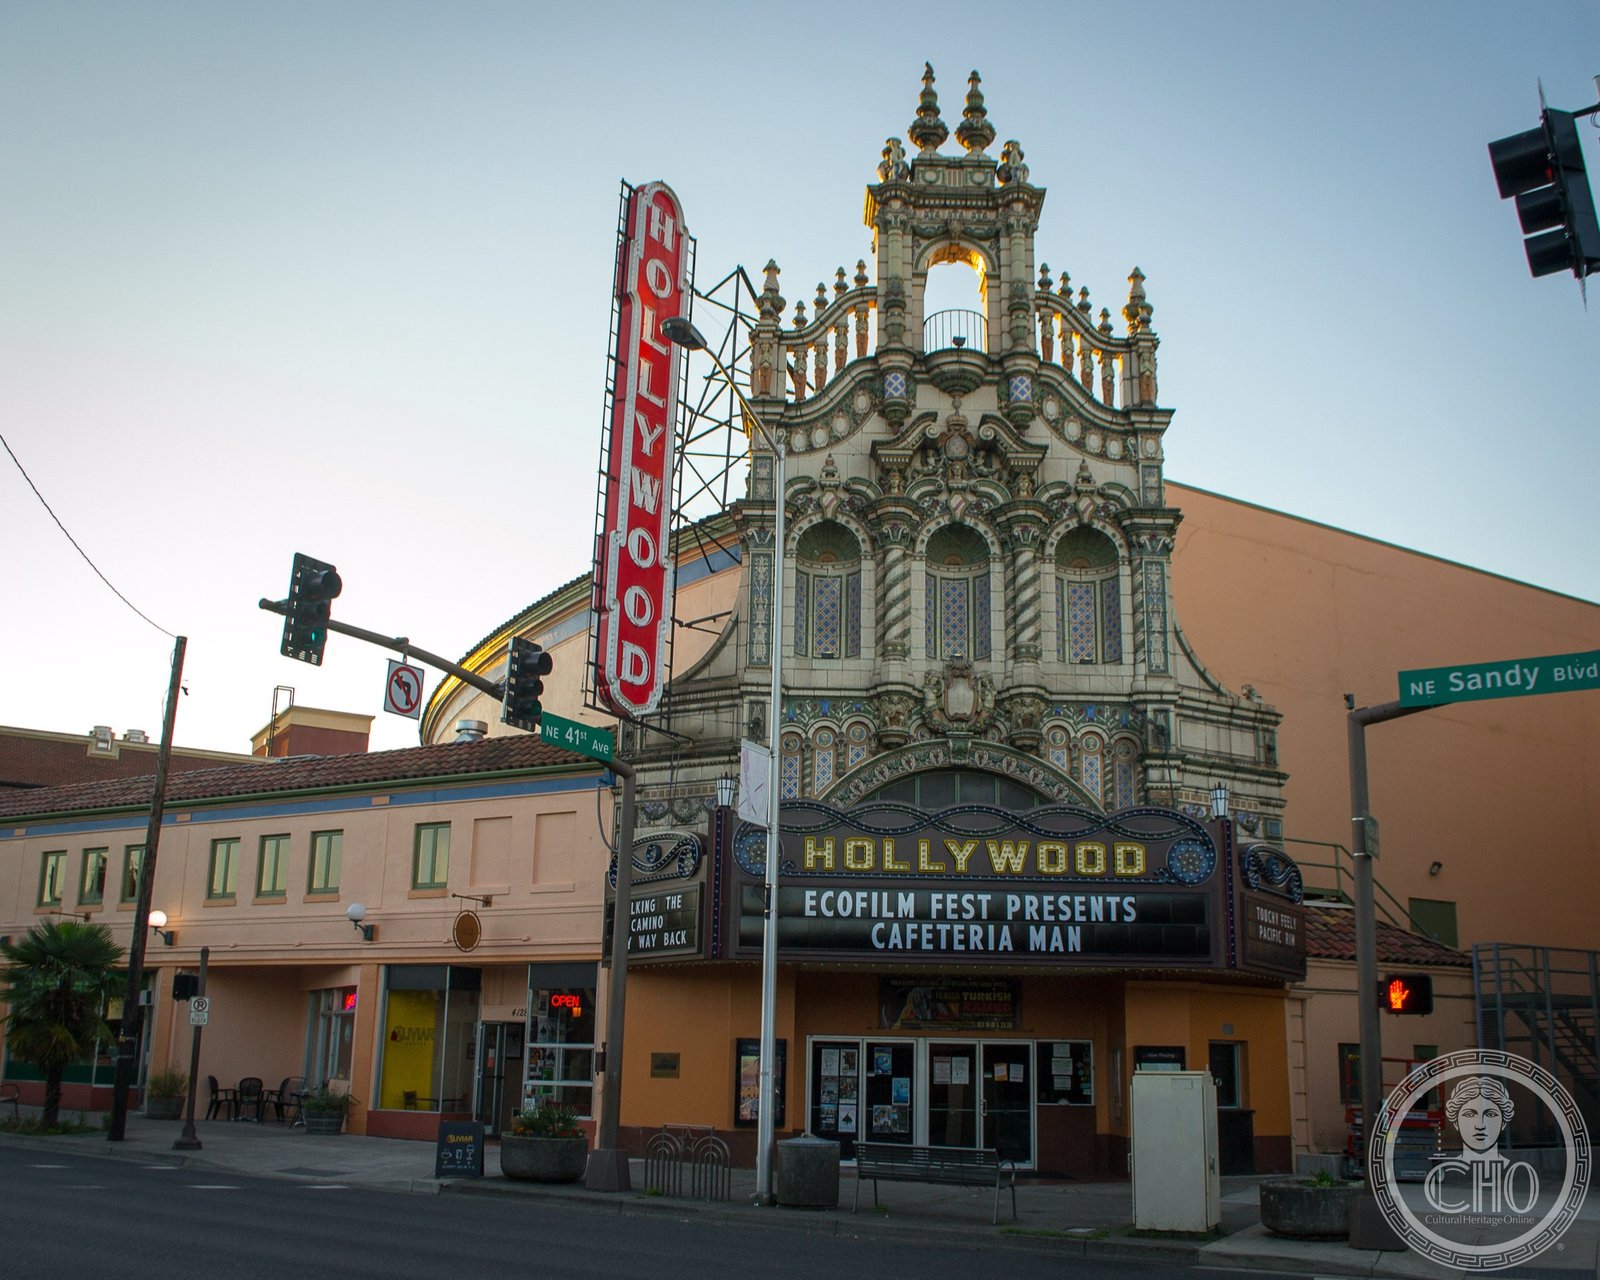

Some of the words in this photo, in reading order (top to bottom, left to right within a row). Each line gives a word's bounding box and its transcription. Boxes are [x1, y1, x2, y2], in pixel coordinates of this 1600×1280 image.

[619, 203, 675, 684] HOLLYWOOD
[1410, 680, 1436, 696] NE
[1449, 664, 1540, 692] Sandy
[1553, 662, 1599, 682] Blvd
[545, 725, 560, 740] NE
[565, 727, 587, 746] 41st
[592, 740, 609, 755] Ave
[804, 836, 1146, 877] HOLLYWOOD
[631, 898, 656, 915] LKING
[666, 895, 682, 910] THE
[804, 890, 915, 918] ECOFILM
[931, 893, 992, 920] FEST
[1006, 894, 1137, 922] PRESENTS
[631, 915, 664, 932] CAMINO
[1281, 913, 1297, 930] FEELY
[639, 933, 657, 949] WAY
[664, 930, 687, 946] BACK
[871, 922, 1013, 951] CAFETERIA
[1029, 925, 1081, 952] MAN
[1259, 925, 1282, 944] PACIFIC
[551, 994, 580, 1007] OPEN
